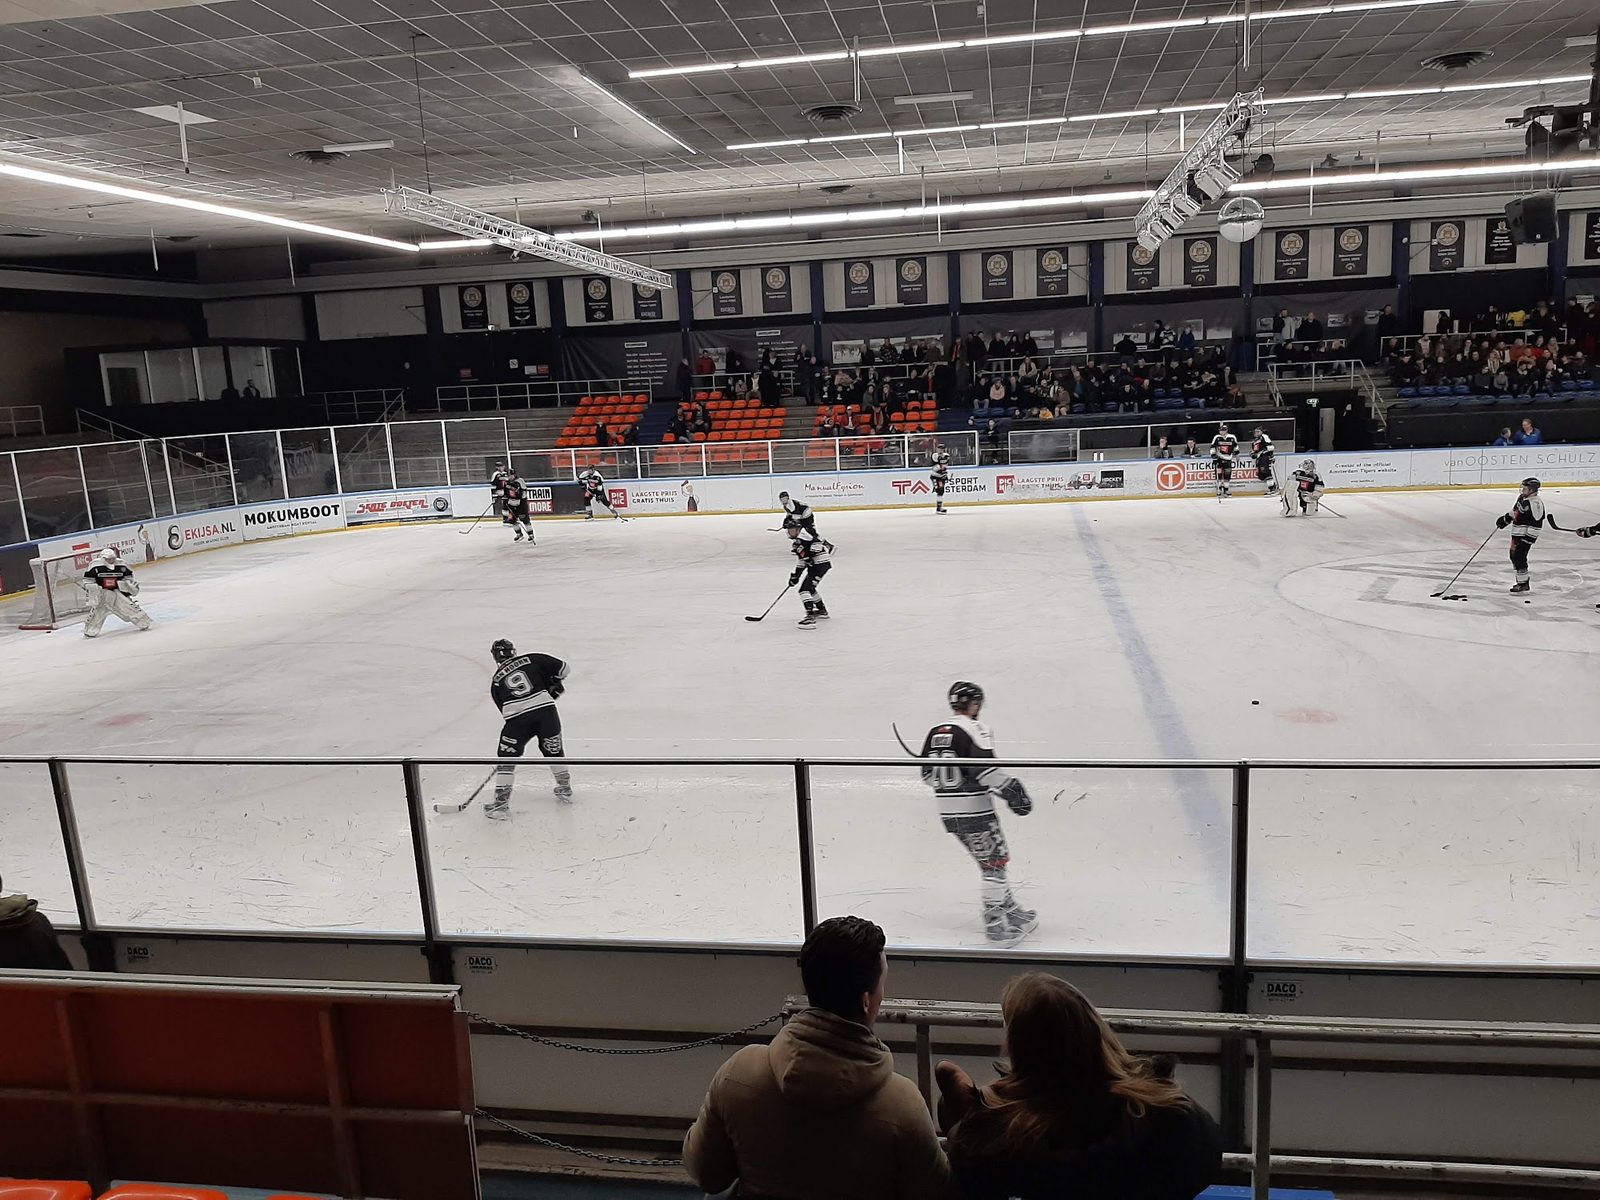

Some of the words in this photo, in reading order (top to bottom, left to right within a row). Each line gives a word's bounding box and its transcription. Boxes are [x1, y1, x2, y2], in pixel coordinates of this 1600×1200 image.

[1536, 452, 1596, 464] SCHULZ
[527, 489, 551, 499] TRAIN
[529, 501, 552, 512] MORE
[244, 504, 340, 526] MOKUMBOOT
[504, 669, 534, 697] 9
[127, 946, 149, 955] DACO
[468, 957, 492, 966] DACO
[1267, 983, 1296, 993] DACO
